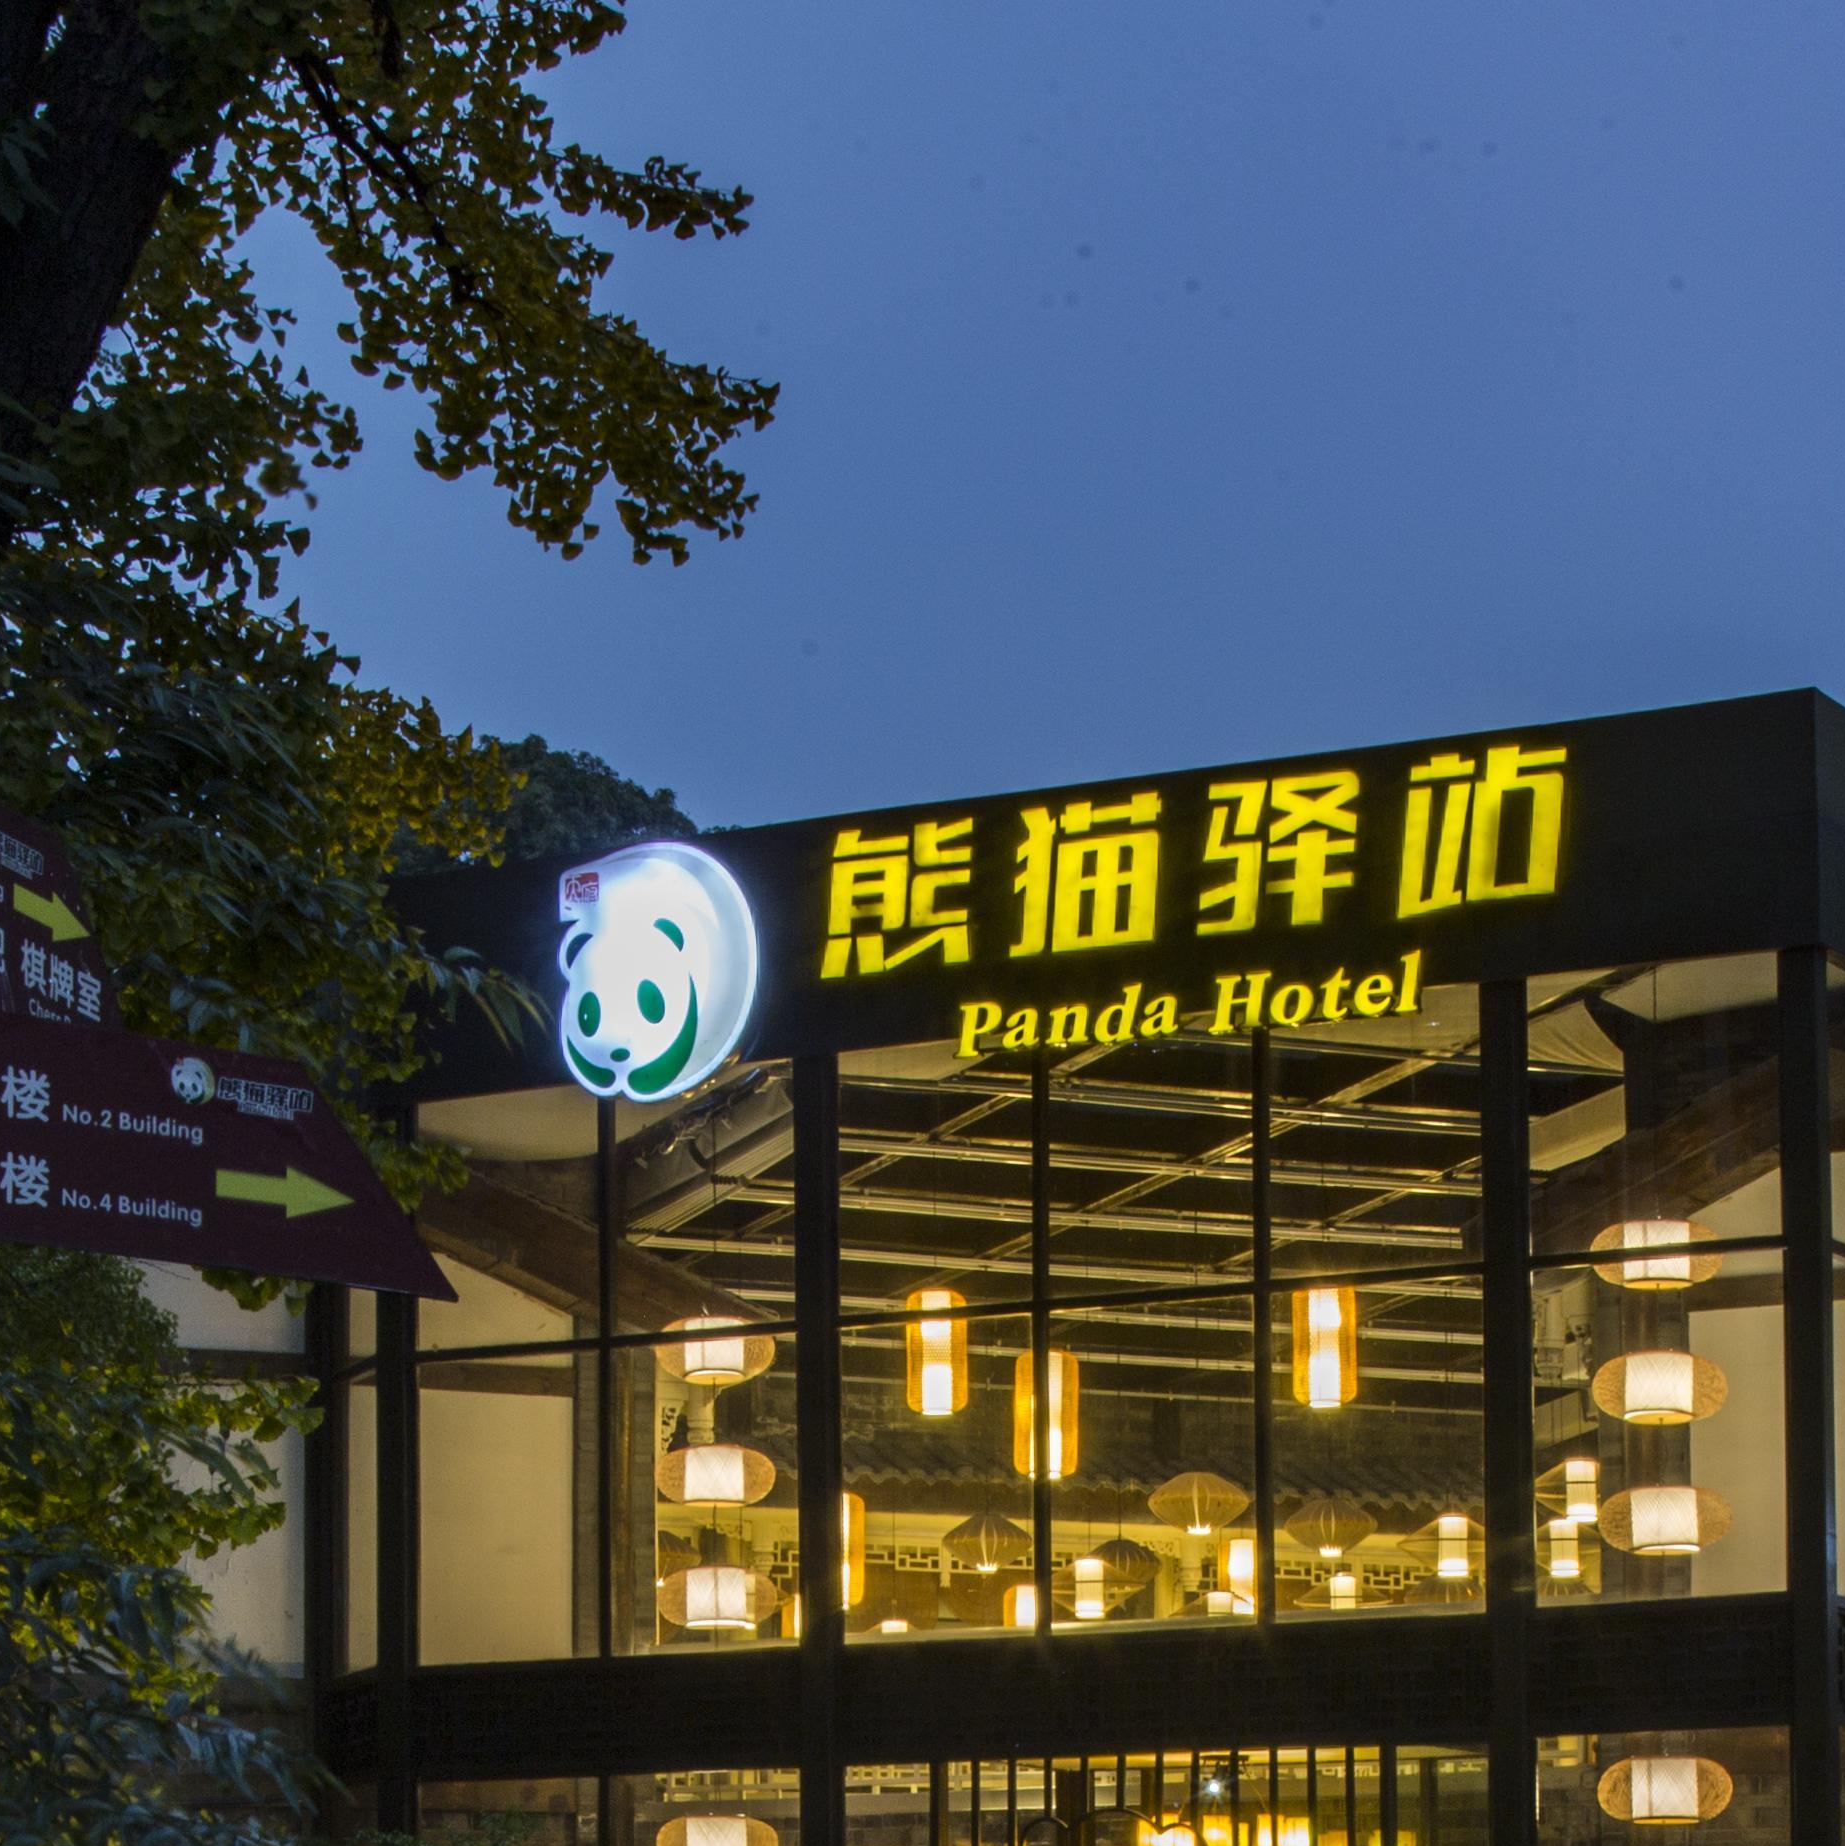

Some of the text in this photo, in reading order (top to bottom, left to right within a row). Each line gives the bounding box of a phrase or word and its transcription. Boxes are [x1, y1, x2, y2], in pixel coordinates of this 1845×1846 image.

[820, 746, 1568, 979] 熊猫驿站
[20, 937, 102, 1023] 棋牌室
[954, 948, 1423, 1058] Panda Hotel
[62, 1103, 112, 1129] No.2
[118, 1111, 204, 1146] Building
[61, 1187, 112, 1213] No.4
[118, 1195, 203, 1228] Building
